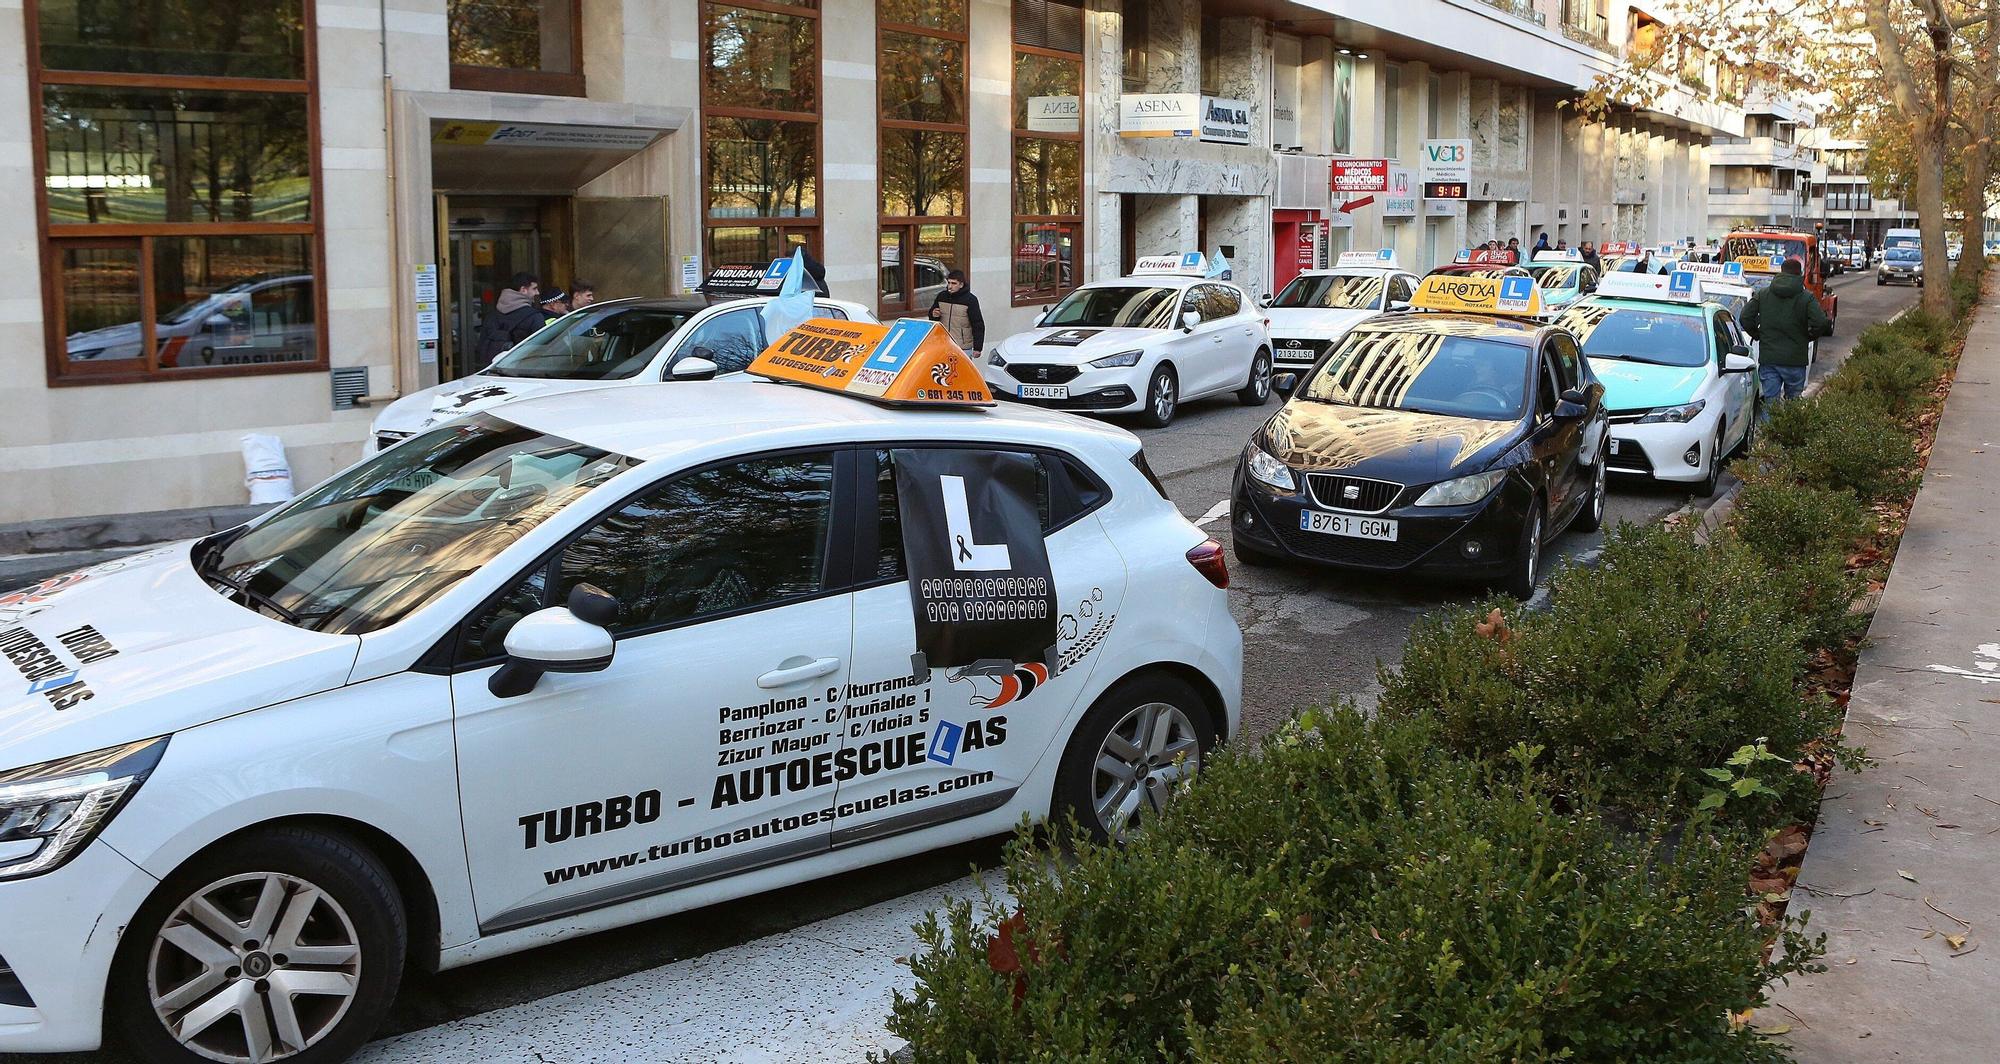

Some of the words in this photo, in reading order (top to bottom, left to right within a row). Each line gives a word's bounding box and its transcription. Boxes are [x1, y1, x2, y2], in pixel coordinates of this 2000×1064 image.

[1134, 100, 1182, 113] ASENA
[1344, 167, 1372, 176] MÉDICOS
[1334, 175, 1385, 184] CONDUCTORES
[1438, 186, 1461, 197] 9:19
[1185, 254, 1194, 265] L
[1380, 251, 1387, 260] L
[1773, 257, 1780, 265] L
[770, 262, 782, 276] L
[1139, 259, 1176, 269] Orvina
[1680, 262, 1722, 275] Cirauqui
[1727, 264, 1736, 274] L
[712, 269, 767, 279] INDURAIN
[1507, 280, 1523, 297] L
[1674, 274, 1687, 290] L
[1428, 281, 1495, 299] LAROTXA
[1499, 299, 1528, 307] PRACTICAS
[876, 328, 907, 364] L
[1278, 350, 1297, 358] 2132
[1298, 350, 1313, 358] LSG
[768, 355, 849, 380] AUTOESCUELAS
[855, 369, 895, 386] PRACTICAS
[927, 389, 944, 399] 681
[946, 390, 964, 400] 345
[967, 390, 983, 401] 108
[1023, 387, 1046, 397] 8894
[1047, 388, 1065, 398] LPF
[940, 474, 1012, 571] L
[1312, 513, 1350, 534] 8761
[1360, 519, 1391, 538] GGM
[922, 578, 1046, 595] AUTOESCUELAS
[928, 603, 959, 619] SIN
[965, 601, 1046, 617] EXAMENES
[55, 624, 120, 665] TURBO
[719, 697, 808, 724] Pamplona
[826, 675, 915, 703] C/Iturrama
[719, 717, 805, 746] Berriozar
[825, 694, 917, 723] C/Iruñalde
[923, 688, 931, 702] 1
[717, 746, 766, 767] Zizur
[771, 730, 831, 756] Mayor
[850, 714, 913, 738] C/Idoia
[918, 708, 930, 723] 5
[518, 788, 662, 850] TURBO
[710, 715, 1008, 810] AUTOESCUELAS
[543, 770, 994, 885] www.turboautoescuelas.com
